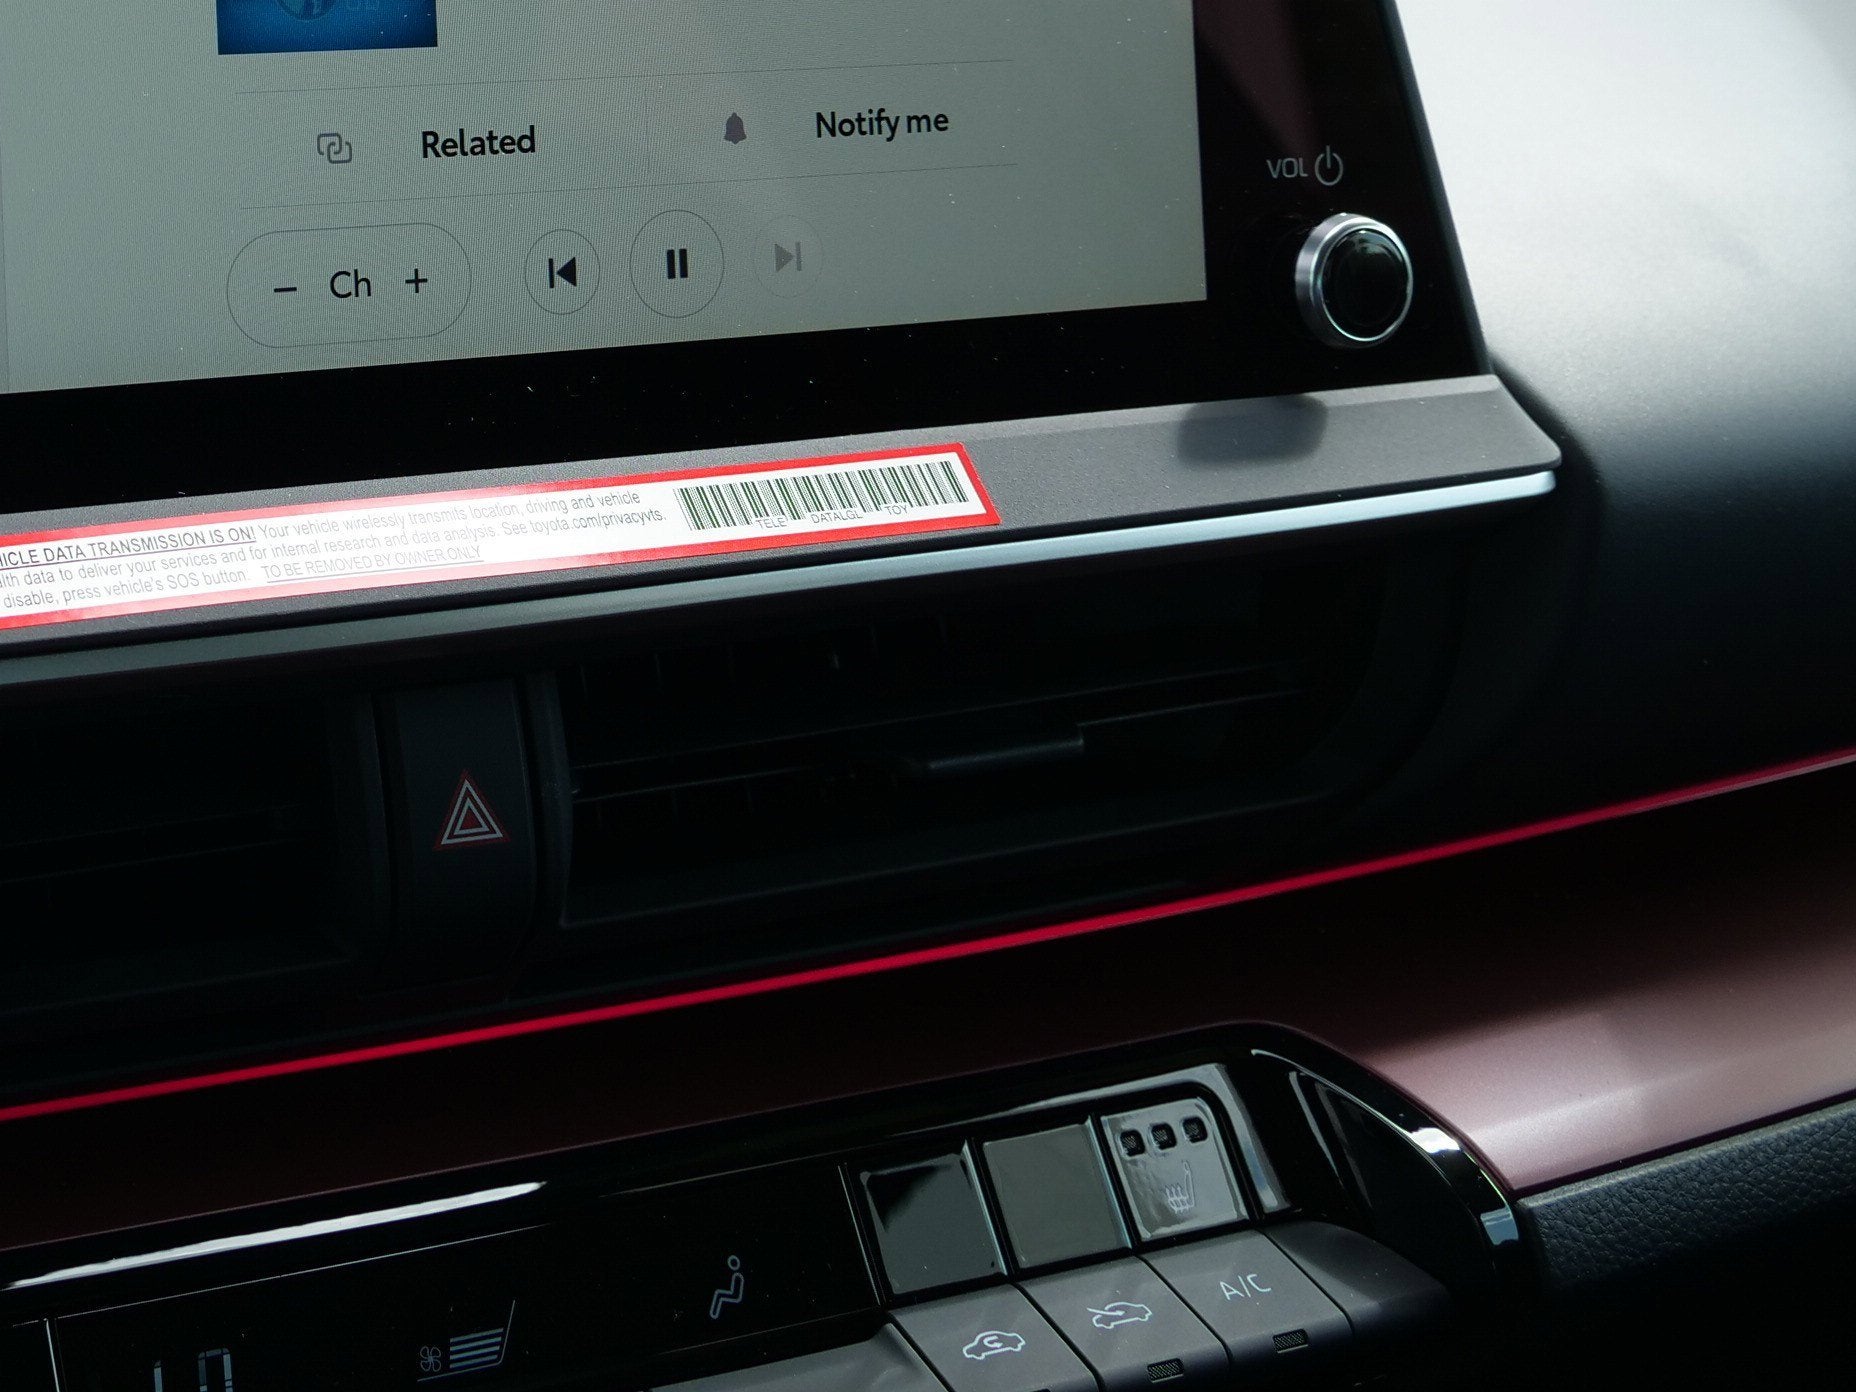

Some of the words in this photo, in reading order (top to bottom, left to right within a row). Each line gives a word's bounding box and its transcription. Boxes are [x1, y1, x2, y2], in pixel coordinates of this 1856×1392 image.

[815, 106, 900, 142] Notify
[906, 111, 949, 134] me
[420, 125, 537, 161] Related
[1266, 157, 1309, 179] VOL
[329, 267, 372, 300] Ch
[44, 544, 87, 562] DATA
[88, 529, 206, 557] TRANSMISSION
[209, 529, 225, 544] IS
[228, 526, 256, 542] ON!
[258, 523, 290, 540] Your
[294, 518, 339, 536] vehicle
[343, 512, 406, 531] wirelessly
[408, 506, 468, 525] transmits
[468, 502, 525, 519] location,
[526, 497, 569, 515] driving
[571, 494, 596, 510] and
[598, 490, 641, 507] vehicle
[756, 515, 787, 529] TELE
[884, 503, 910, 516] TOY
[24, 570, 55, 586] data
[59, 567, 73, 580] to
[79, 562, 123, 579] deliver
[125, 559, 156, 577] your
[160, 552, 218, 570] services
[221, 544, 247, 564] and
[249, 544, 267, 560] for
[271, 539, 321, 557] internal
[324, 534, 381, 553] research
[385, 531, 410, 548] and
[412, 528, 440, 544] data
[501, 521, 528, 536] See
[530, 508, 667, 536] toyota.com/privacyvts.
[4, 590, 59, 608] disable,
[63, 586, 101, 606] press
[105, 577, 164, 597] vehicle's
[166, 572, 201, 590] SOS
[202, 569, 250, 585] button.
[261, 564, 281, 579] TO
[284, 562, 305, 577] BE
[305, 556, 376, 574] REMOVED
[376, 552, 396, 567] BY
[395, 548, 444, 565] OWNER
[446, 545, 481, 560] ONLY
[1219, 1272, 1274, 1302] A/C
